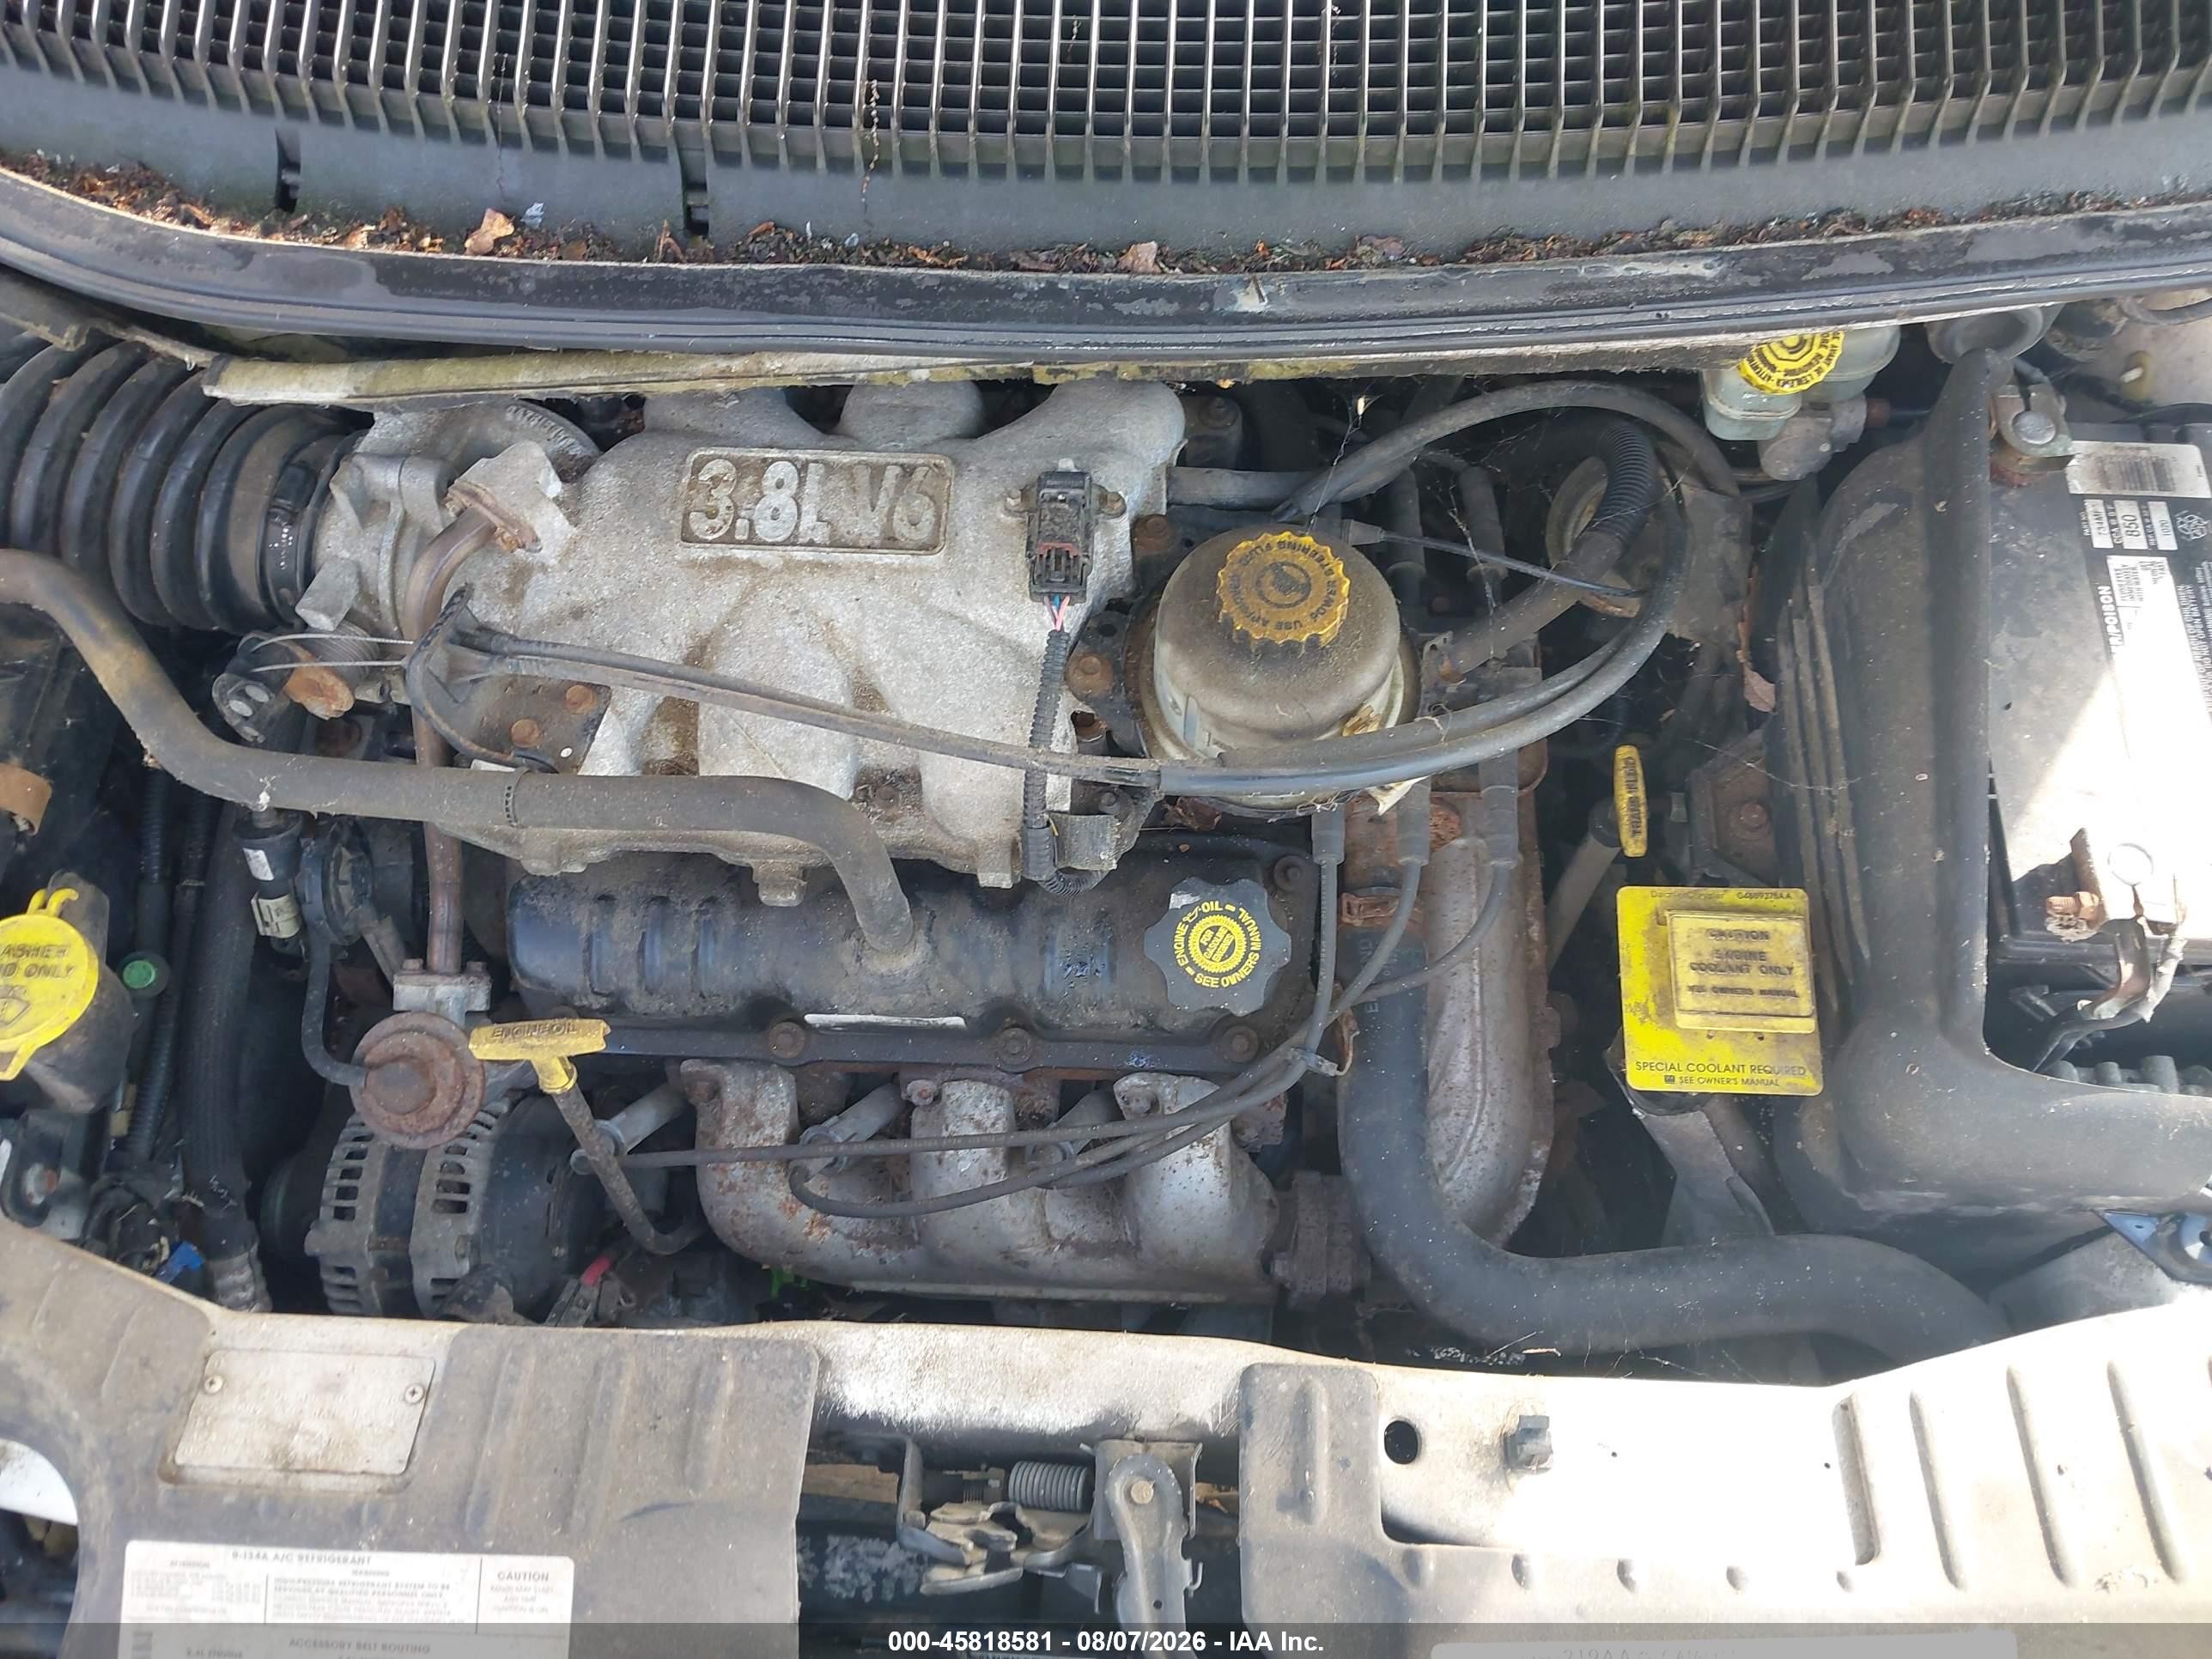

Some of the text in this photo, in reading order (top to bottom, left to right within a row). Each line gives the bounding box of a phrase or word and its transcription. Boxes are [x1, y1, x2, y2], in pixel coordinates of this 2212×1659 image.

[689, 458, 936, 548] 3.8L V6
[2122, 514, 2140, 537] 850
[1277, 540, 1335, 577] STEERING
[1309, 580, 1337, 622] POWER
[1274, 619, 1304, 631] USE
[1173, 900, 1224, 967] ENGINE OIL
[1199, 928, 1215, 946] FOR
[1705, 928, 1770, 941] CAUTION
[0, 945, 70, 958] ASHER
[1194, 907, 1262, 988] SEE OWNERS MANUAL
[1715, 949, 1767, 962] ENGINE
[25, 963, 76, 978] ONLY
[1690, 962, 1794, 975] COOLANT ONLY
[492, 1023, 579, 1040] ENGINE OIL
[1635, 1060, 1807, 1075] SPECIAL COOLANT REQUIRED
[1698, 1077, 1738, 1085] OWNER'S
[1741, 1079, 1779, 1087] MANUAL
[273, 1552, 294, 1564] A/C
[297, 1553, 372, 1565] REFRIGERANT
[497, 1571, 550, 1582] CAUTION
[289, 1637, 432, 1655] ACCESSORY BELT ROUTING
